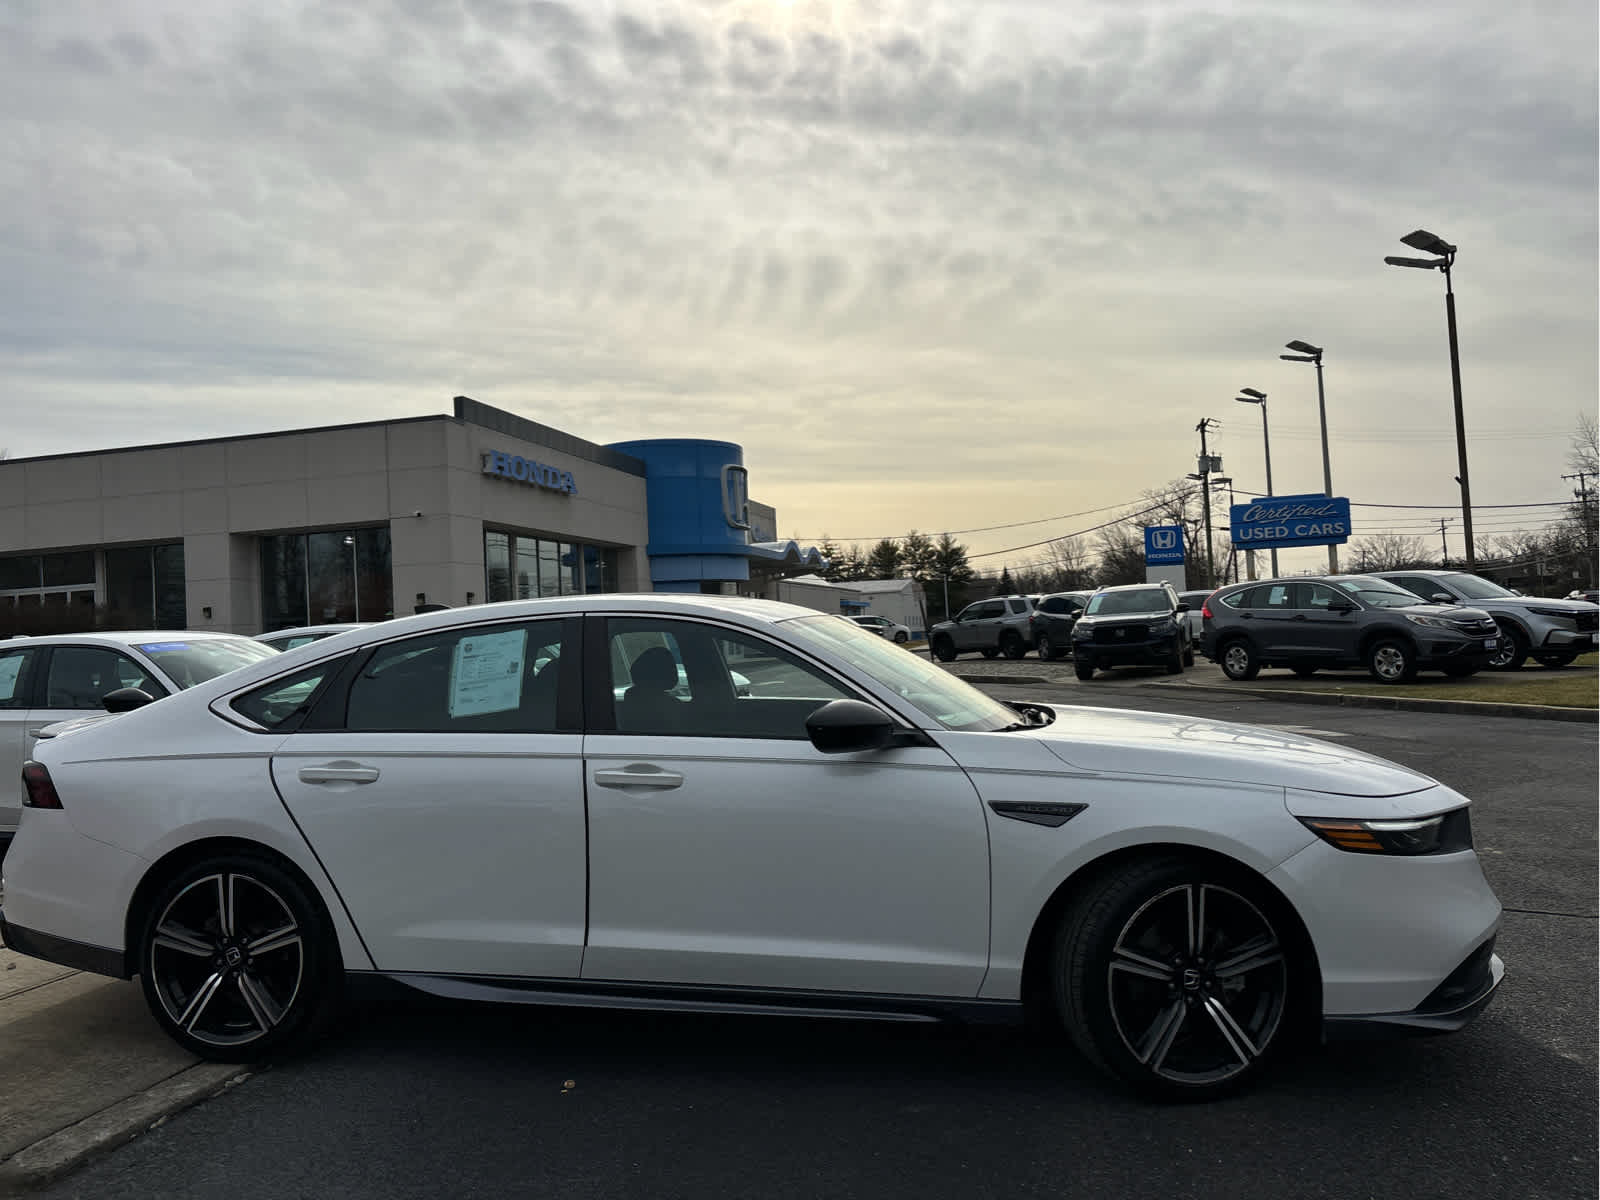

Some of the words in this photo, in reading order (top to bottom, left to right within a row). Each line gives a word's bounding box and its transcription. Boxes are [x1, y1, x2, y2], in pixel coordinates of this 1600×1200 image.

[487, 449, 578, 495] HONDA
[1243, 504, 1338, 524] Certified
[1240, 526, 1289, 540] USED
[1295, 522, 1345, 536] CARS
